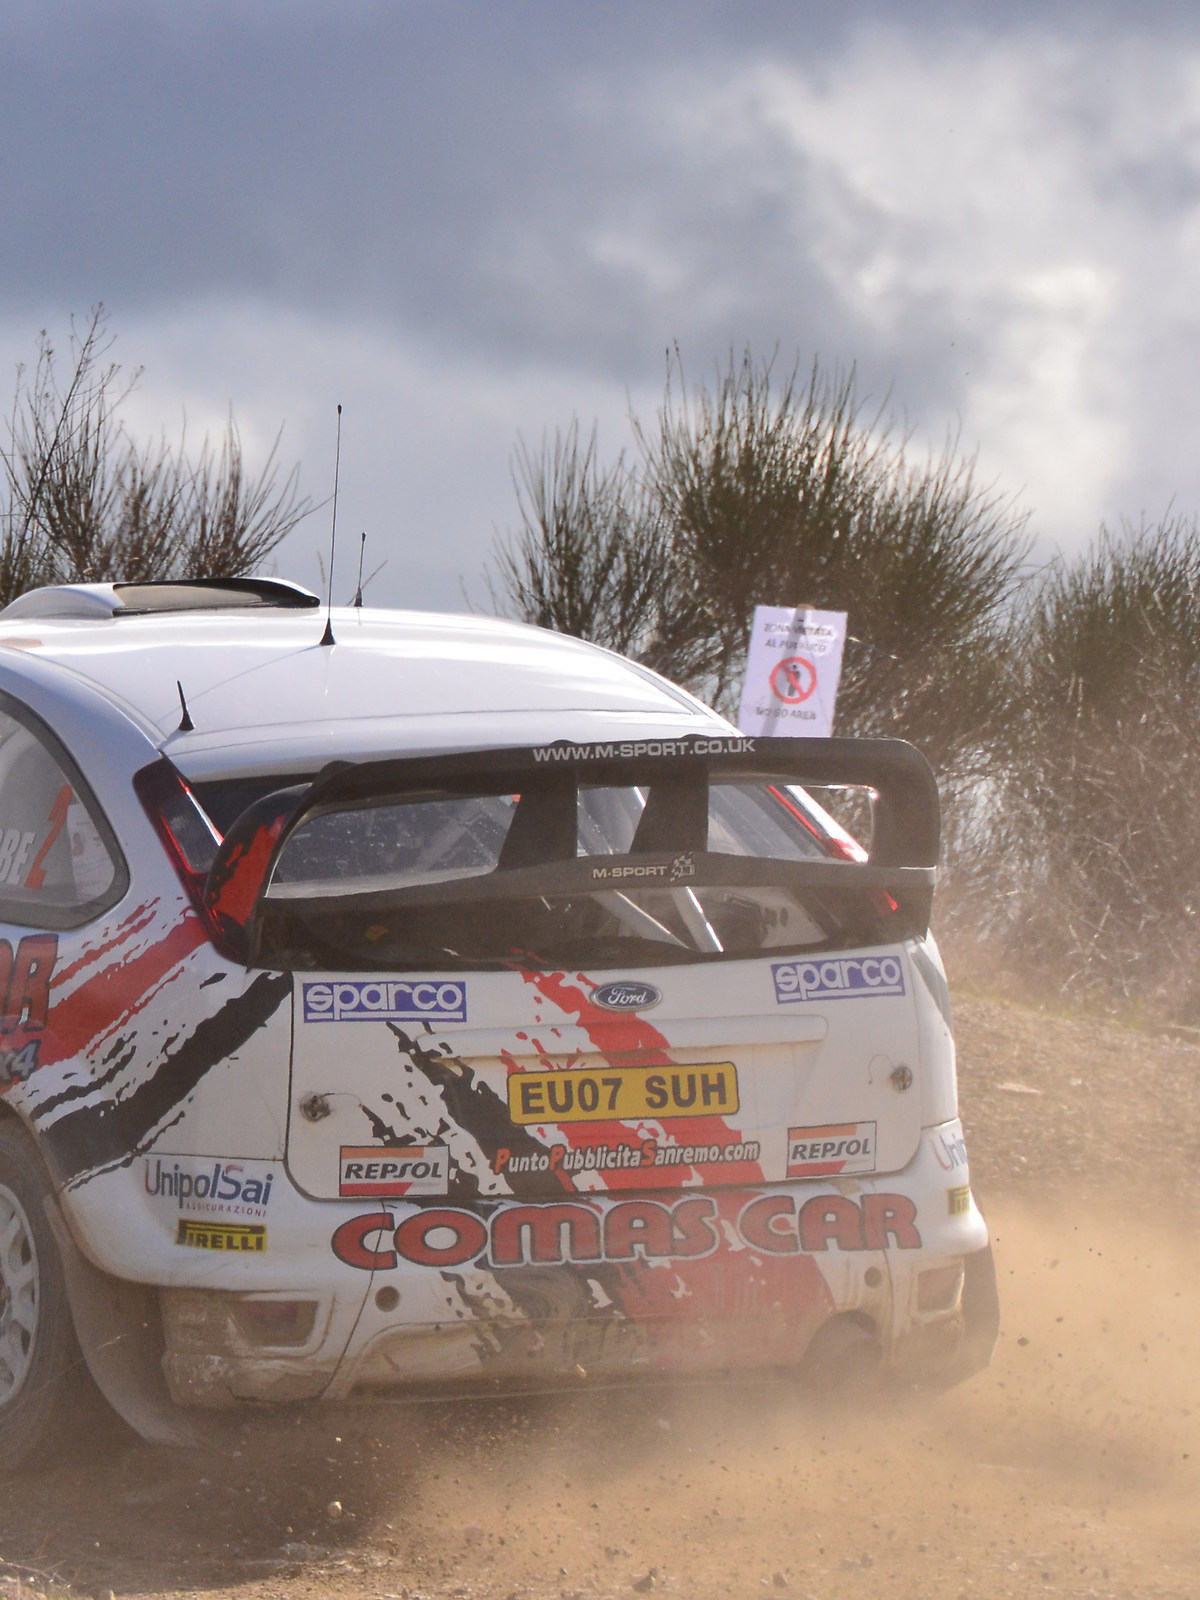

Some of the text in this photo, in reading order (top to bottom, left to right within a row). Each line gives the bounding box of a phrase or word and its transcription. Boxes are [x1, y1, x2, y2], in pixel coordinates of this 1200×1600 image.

[764, 623, 791, 634] ZONA
[533, 739, 756, 762] WWW.M-SPORT.CO.UK
[24, 784, 73, 889] 2
[592, 865, 668, 879] M-SPORT
[775, 960, 902, 1000] sparco
[306, 984, 463, 1020] sparco
[607, 986, 647, 1005] Ford
[520, 1072, 727, 1115] EU07 SUH
[791, 1137, 871, 1161] REPSOL
[144, 1158, 274, 1209] UnipolSai
[344, 1161, 442, 1180] REPSOL
[186, 1202, 267, 1218] ASSICURAZIONI
[177, 1219, 266, 1251] PIRELLI
[330, 1199, 719, 1271] COMAS
[738, 1192, 924, 1254] CAR
